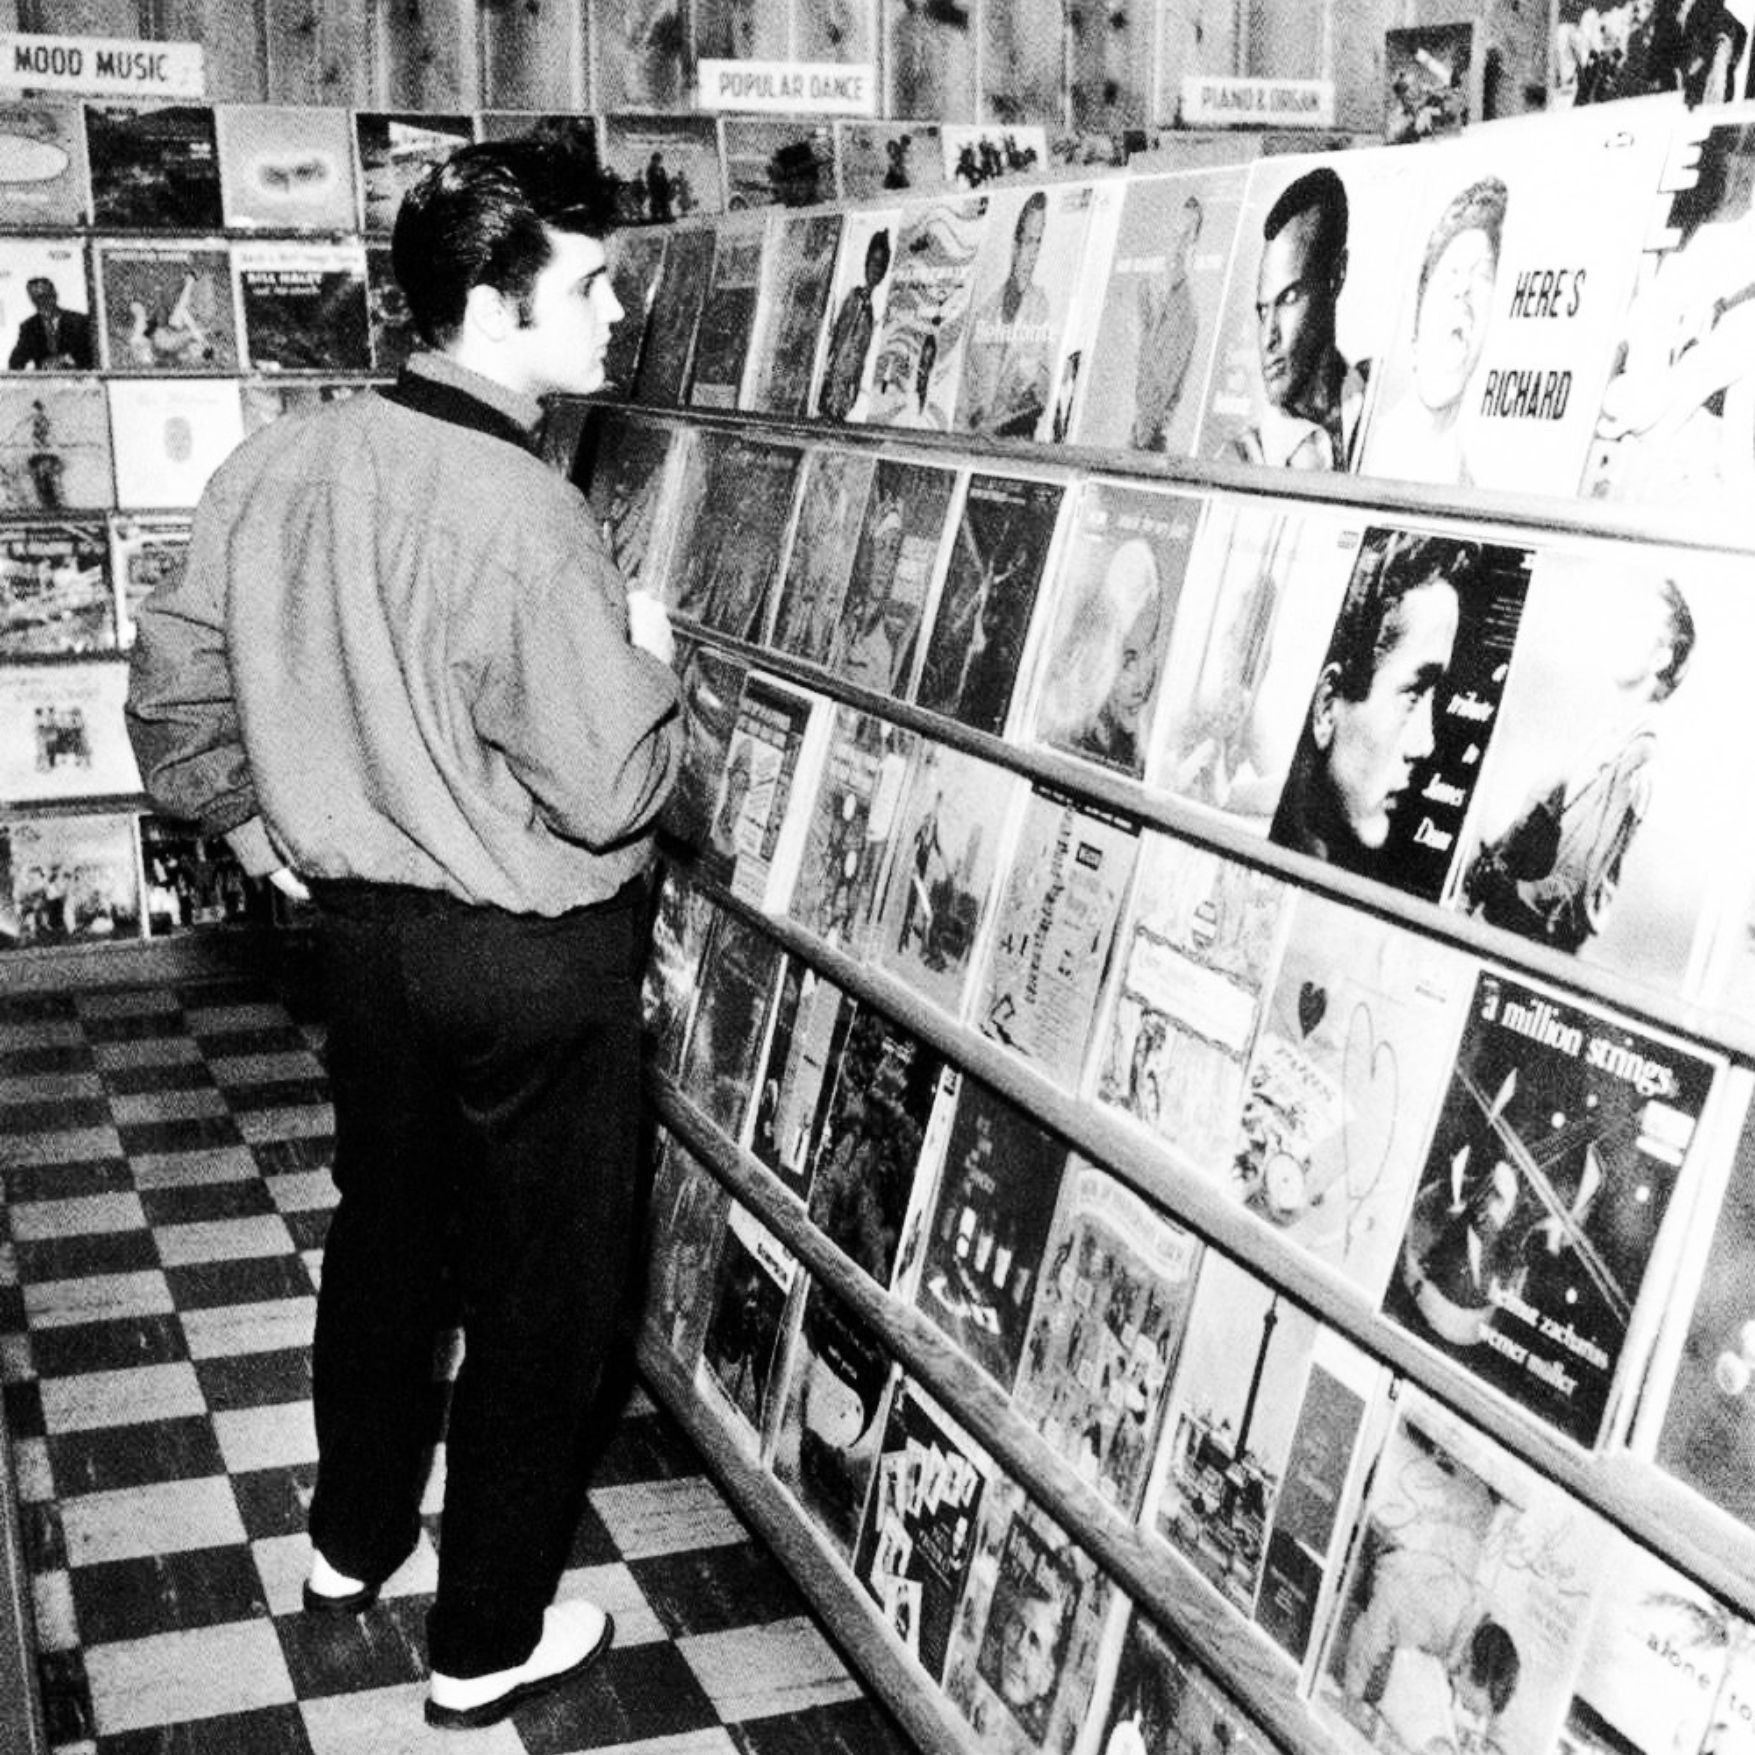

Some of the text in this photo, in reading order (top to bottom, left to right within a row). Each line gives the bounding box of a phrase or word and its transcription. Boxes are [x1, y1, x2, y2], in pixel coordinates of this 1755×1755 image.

[14, 45, 169, 83] MOOD MUSIC
[718, 72, 863, 100] POPULAR DANCE
[1201, 85, 1252, 112] PIANO
[1509, 268, 1588, 320] HERE'S
[1480, 369, 1573, 422] RICHARD
[1481, 993, 1679, 1098] a million strings
[1646, 1632, 1712, 1691] alone
